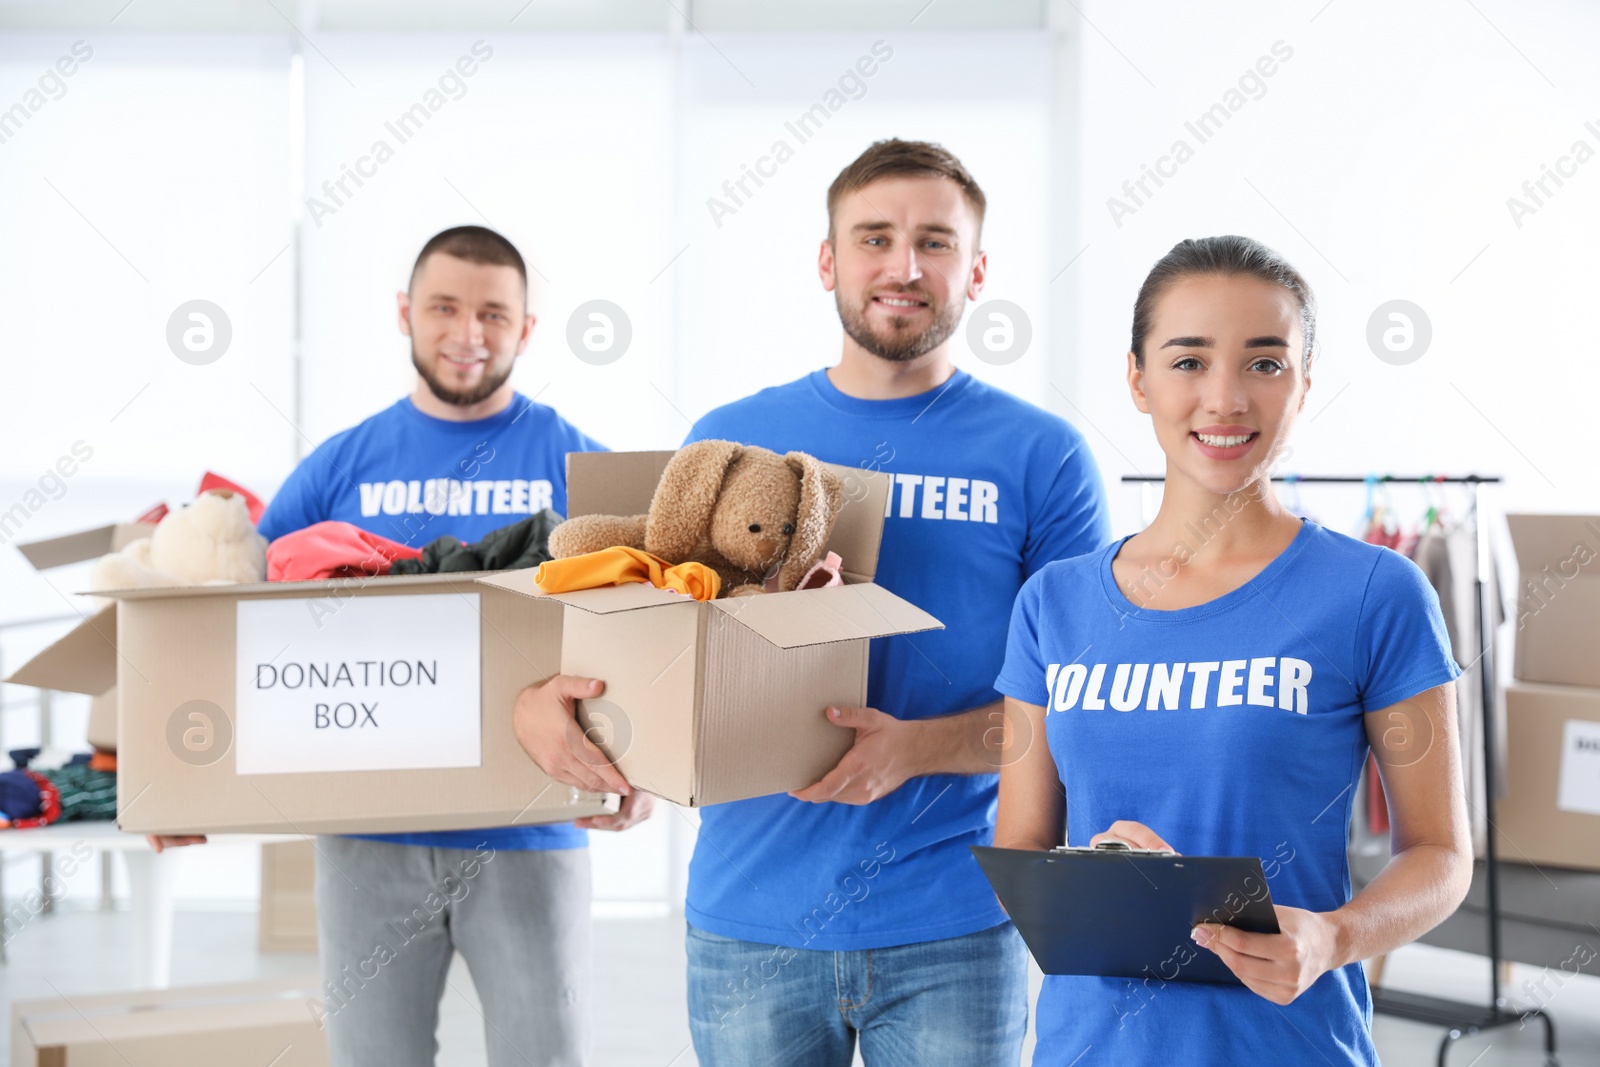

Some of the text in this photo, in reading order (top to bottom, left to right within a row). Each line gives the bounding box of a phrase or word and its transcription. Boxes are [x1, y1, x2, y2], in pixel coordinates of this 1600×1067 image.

[360, 478, 553, 517] VOLUNTEER
[884, 473, 999, 524] TEER
[256, 659, 437, 690] DONATION
[315, 702, 379, 729] BOX
